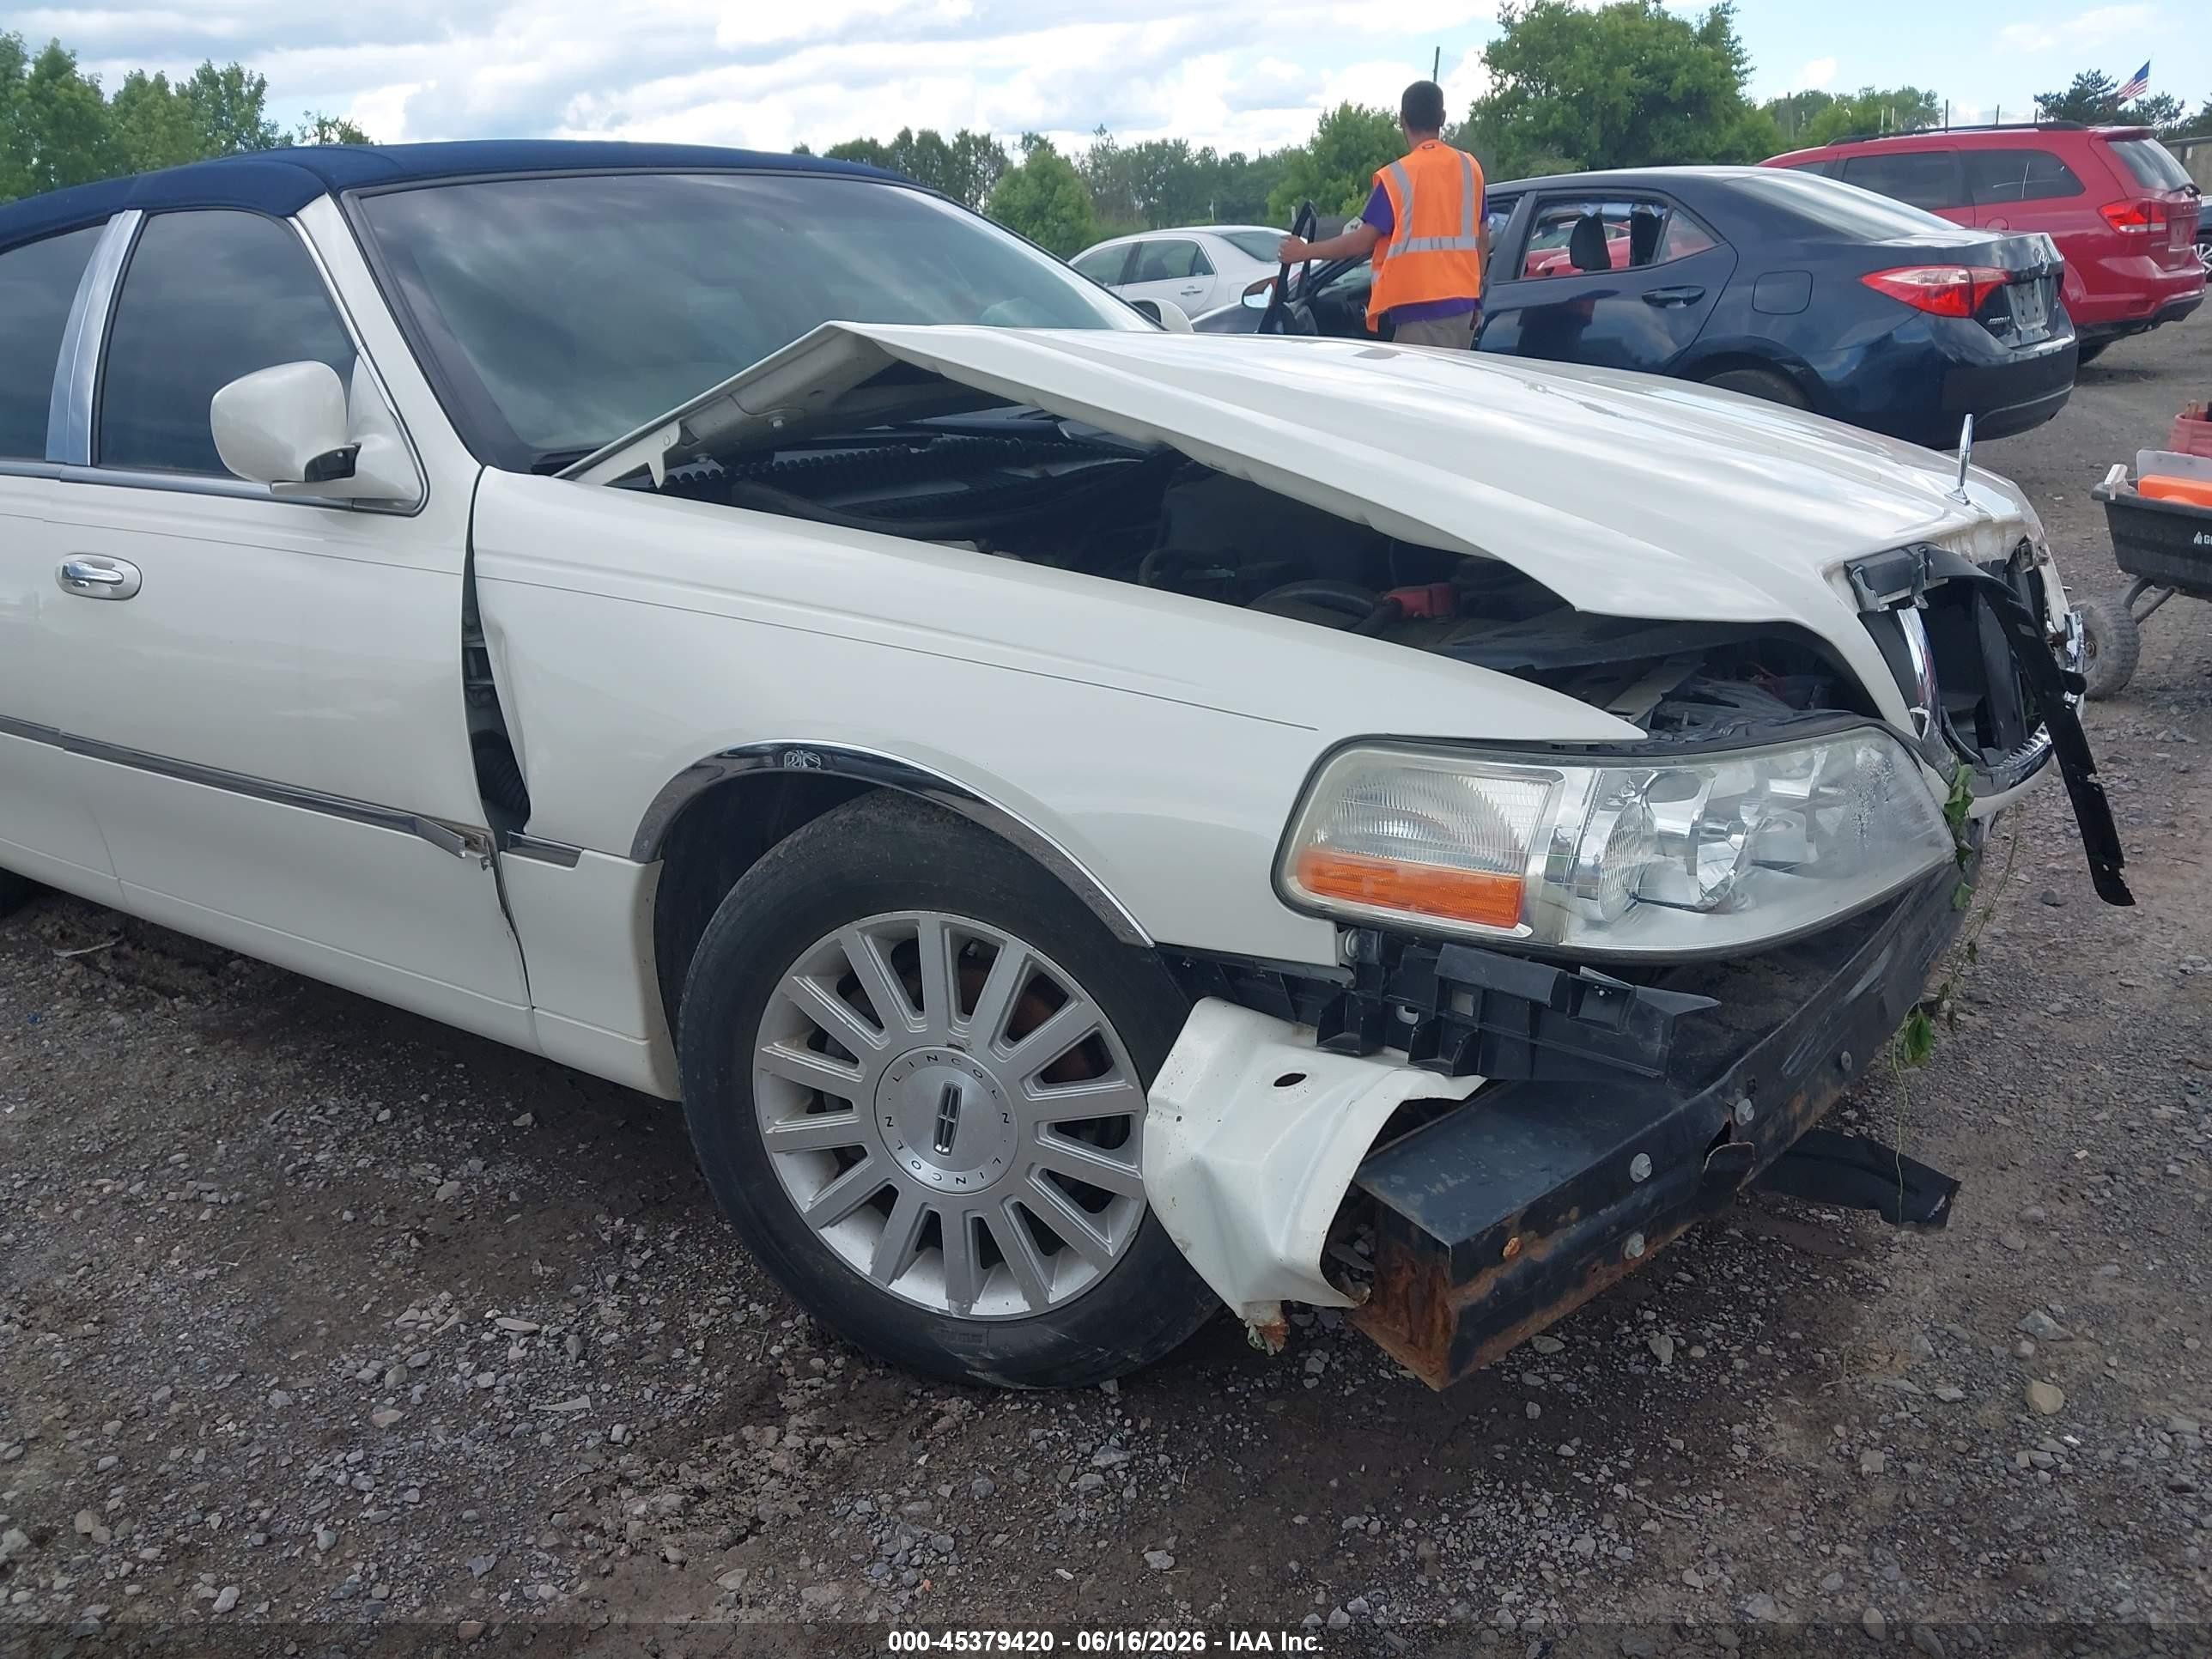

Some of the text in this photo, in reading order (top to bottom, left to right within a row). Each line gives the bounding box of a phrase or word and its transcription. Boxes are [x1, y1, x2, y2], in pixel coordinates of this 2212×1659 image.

[2203, 534, 2212, 545] G
[891, 1054, 1010, 1124] LINCOLN
[884, 1116, 1002, 1185] LINCOLN
